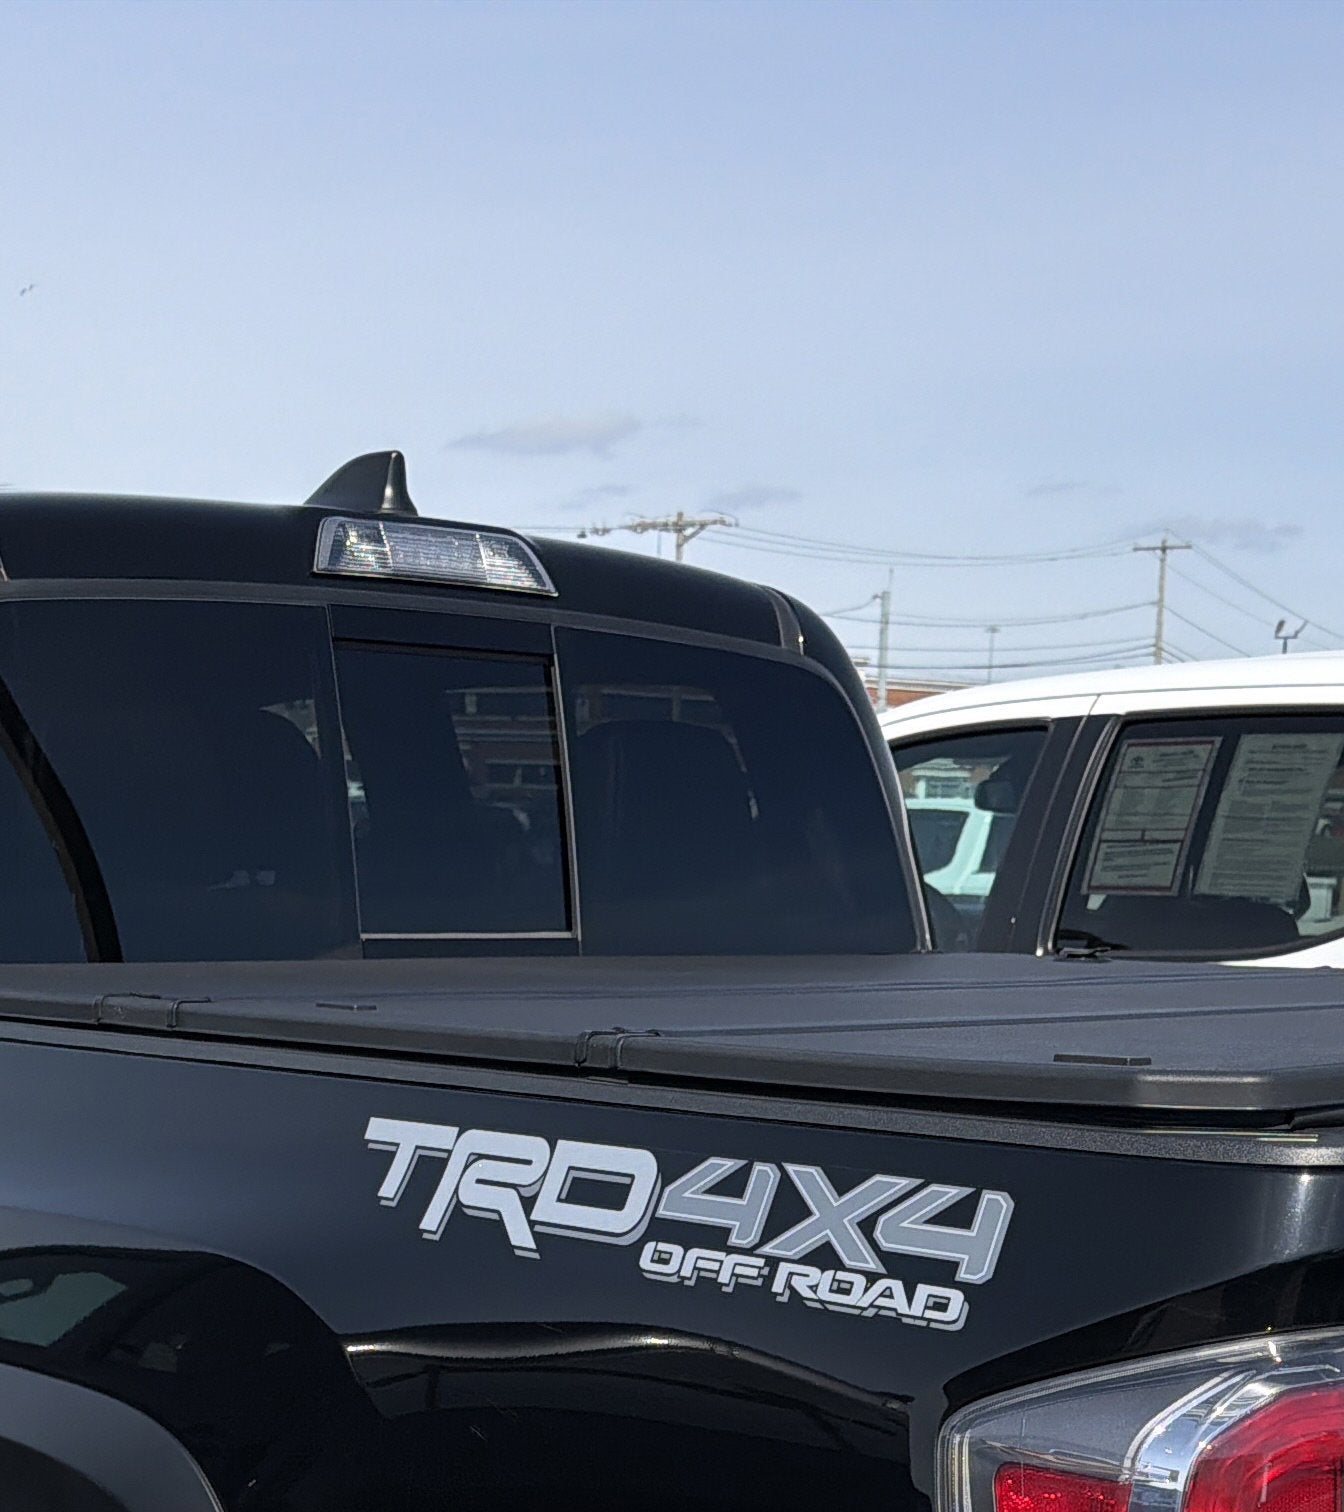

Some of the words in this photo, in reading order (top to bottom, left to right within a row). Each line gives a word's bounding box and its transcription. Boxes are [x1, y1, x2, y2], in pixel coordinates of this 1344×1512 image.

[363, 1116, 661, 1260] TRD
[656, 1156, 1015, 1286] 4X4
[638, 1240, 769, 1294] OFF
[770, 1261, 969, 1332] ROAD
